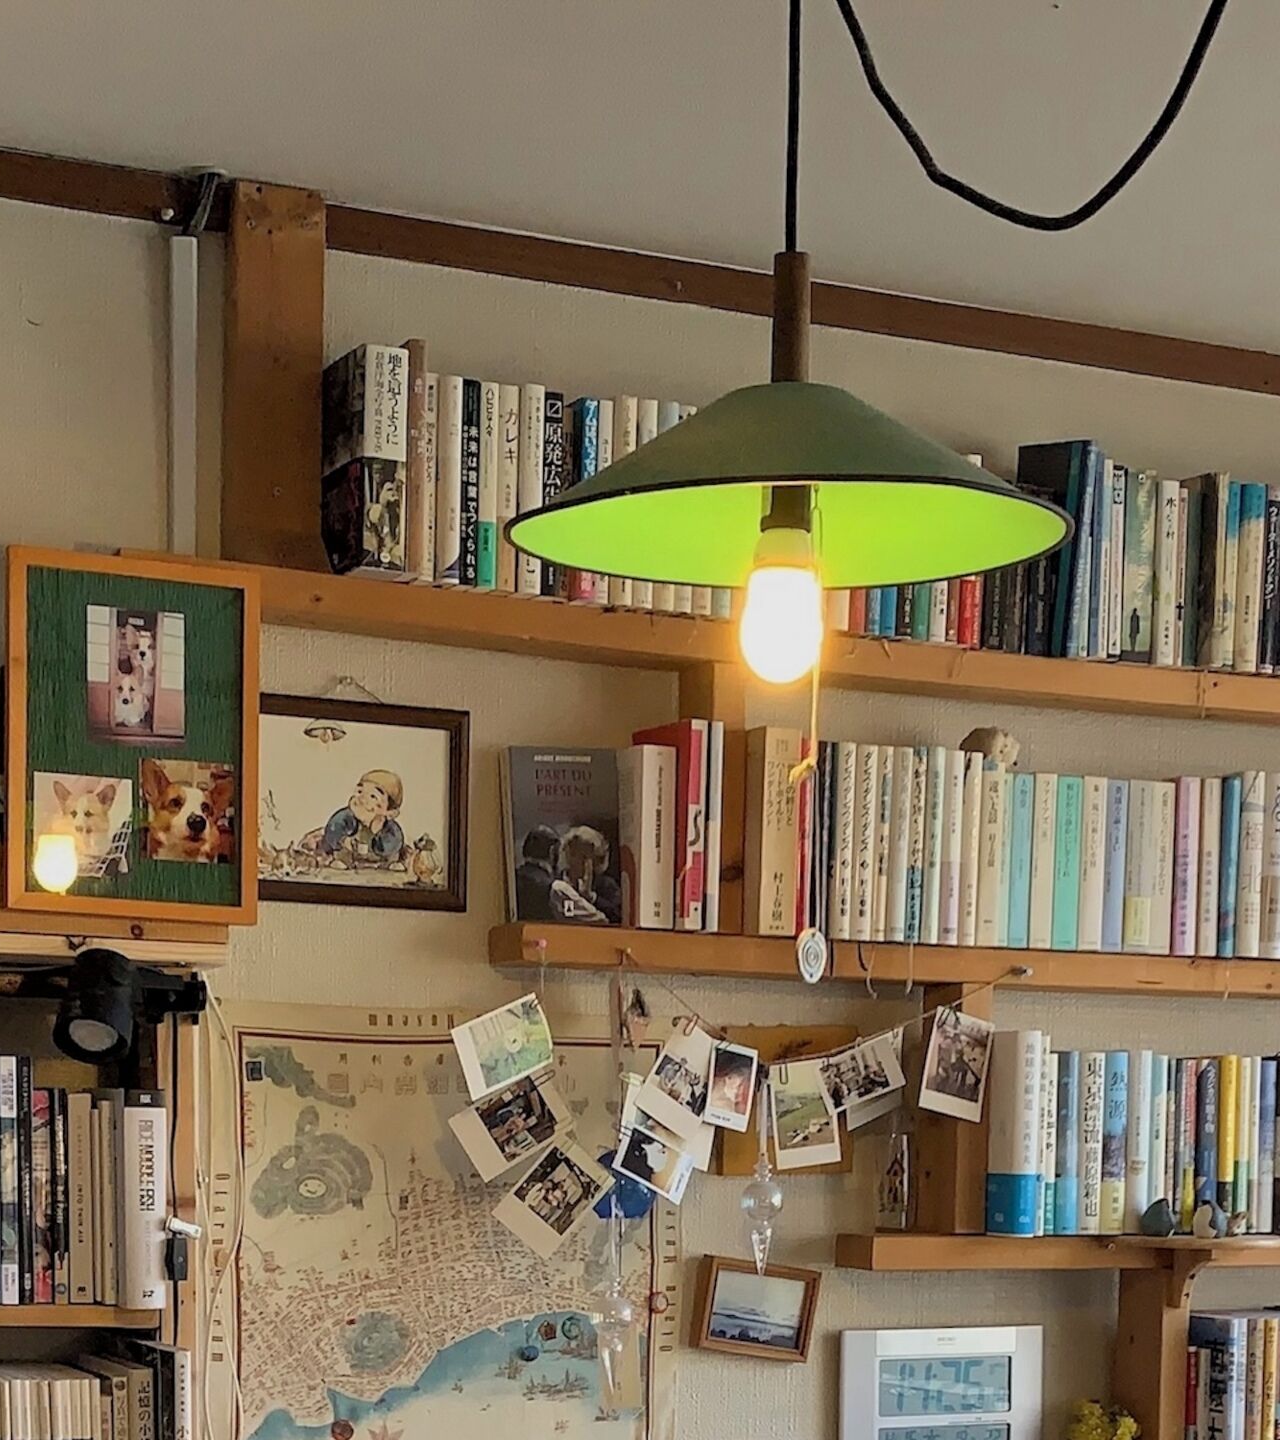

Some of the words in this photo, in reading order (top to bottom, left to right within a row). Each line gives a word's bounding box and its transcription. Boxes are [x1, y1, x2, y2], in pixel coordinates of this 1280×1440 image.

[504, 408, 519, 465] カレキ
[466, 425, 479, 580] 未来は言葉でつくられる
[987, 780, 1000, 825] 遠い太鼓
[770, 871, 785, 923] 村上春樹
[212, 1173, 231, 1246] Otaru
